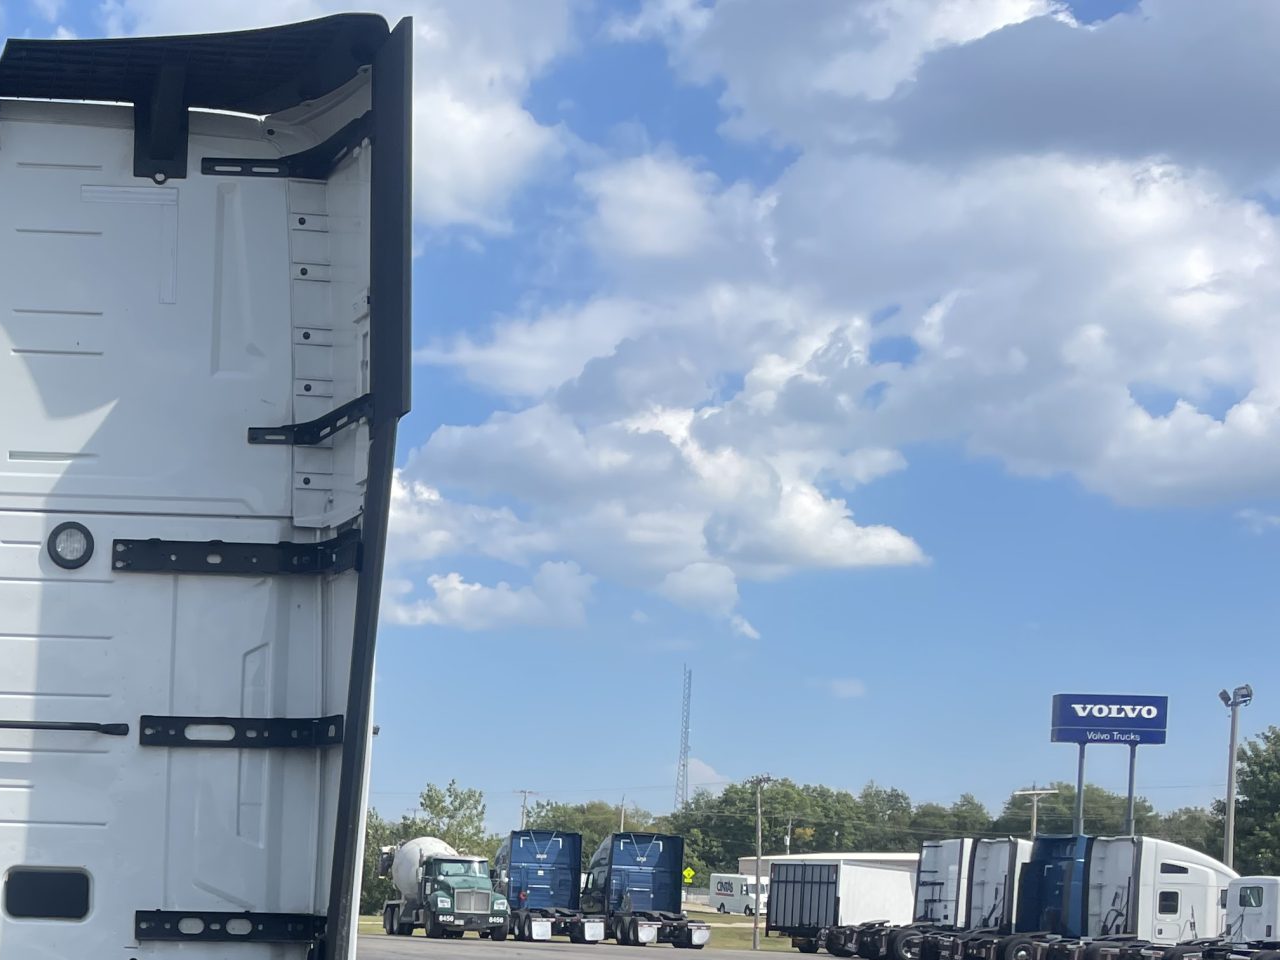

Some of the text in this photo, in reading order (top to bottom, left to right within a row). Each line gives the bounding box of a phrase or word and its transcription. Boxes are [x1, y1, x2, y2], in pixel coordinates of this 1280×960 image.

[1071, 703, 1158, 719] VOLVO
[1086, 731, 1140, 741] Volvo Trucks
